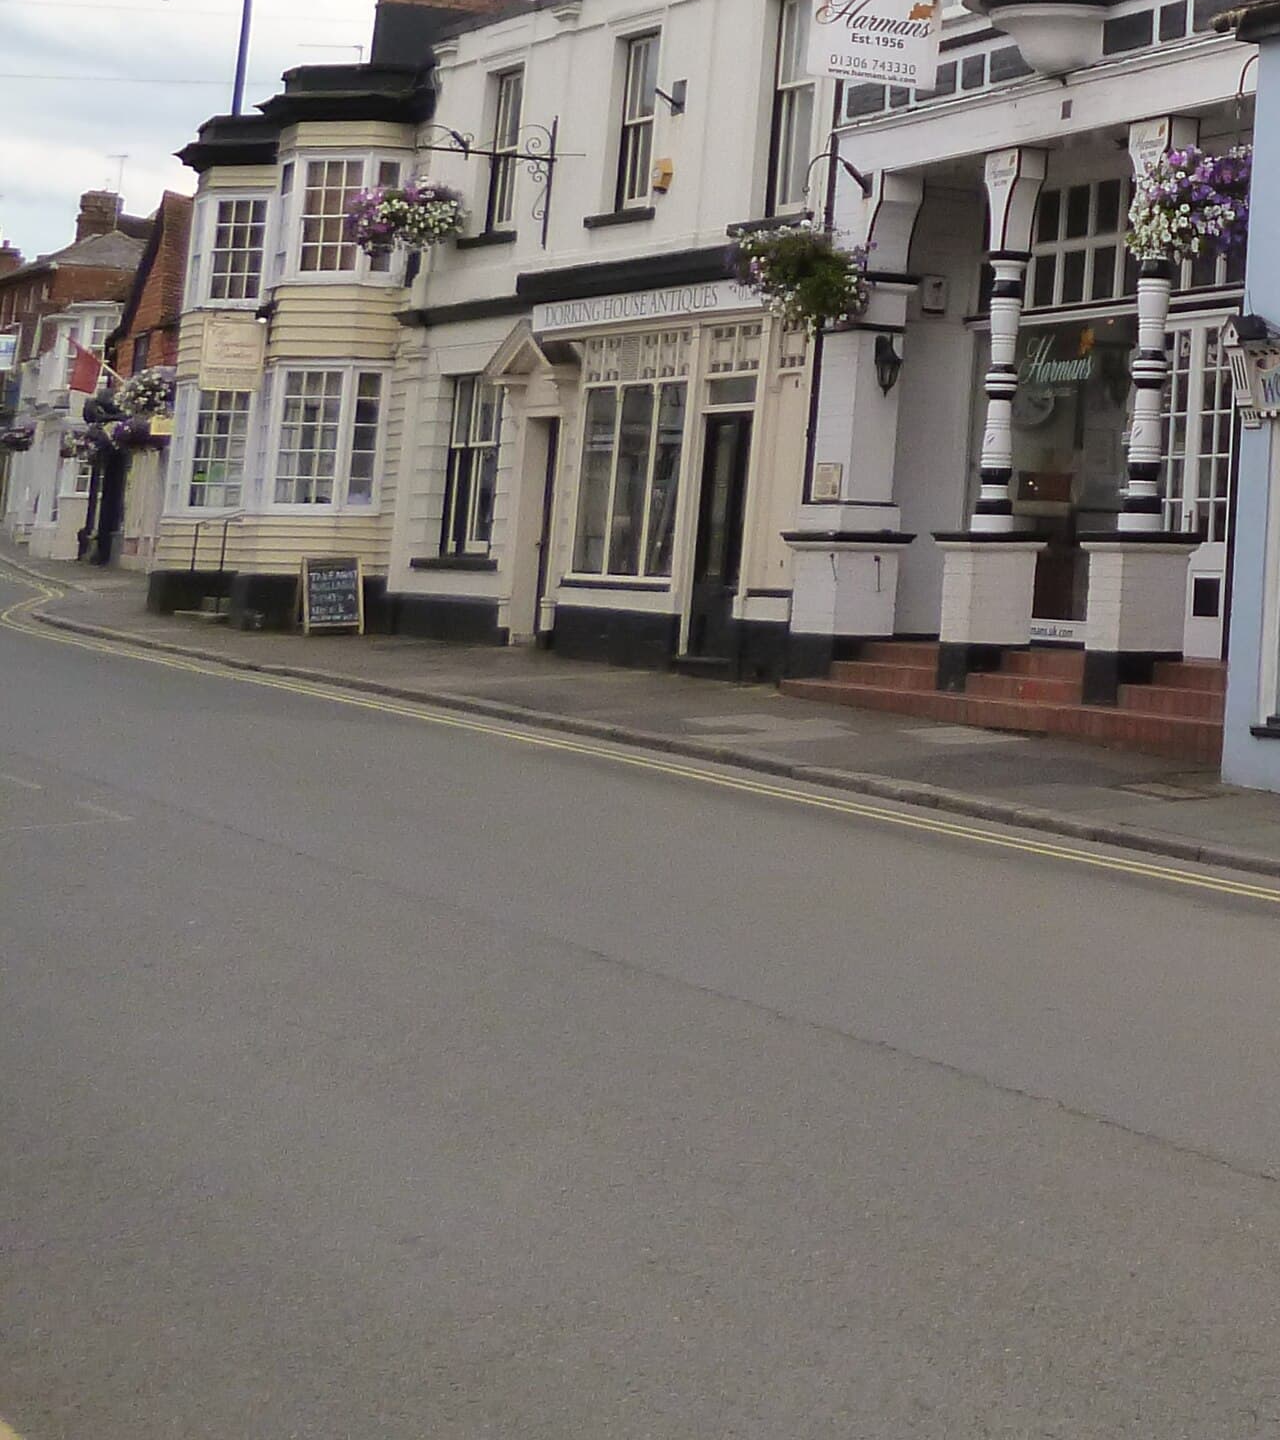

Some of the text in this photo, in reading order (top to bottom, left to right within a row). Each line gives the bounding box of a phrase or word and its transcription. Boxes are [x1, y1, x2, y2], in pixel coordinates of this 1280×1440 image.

[875, 35, 905, 49] 1956
[830, 54, 917, 76] 01306 743330
[544, 301, 600, 327] DORKING
[603, 293, 647, 320] HOUSE
[650, 284, 719, 313] ANTIQUES
[1018, 334, 1092, 385] Harmans
